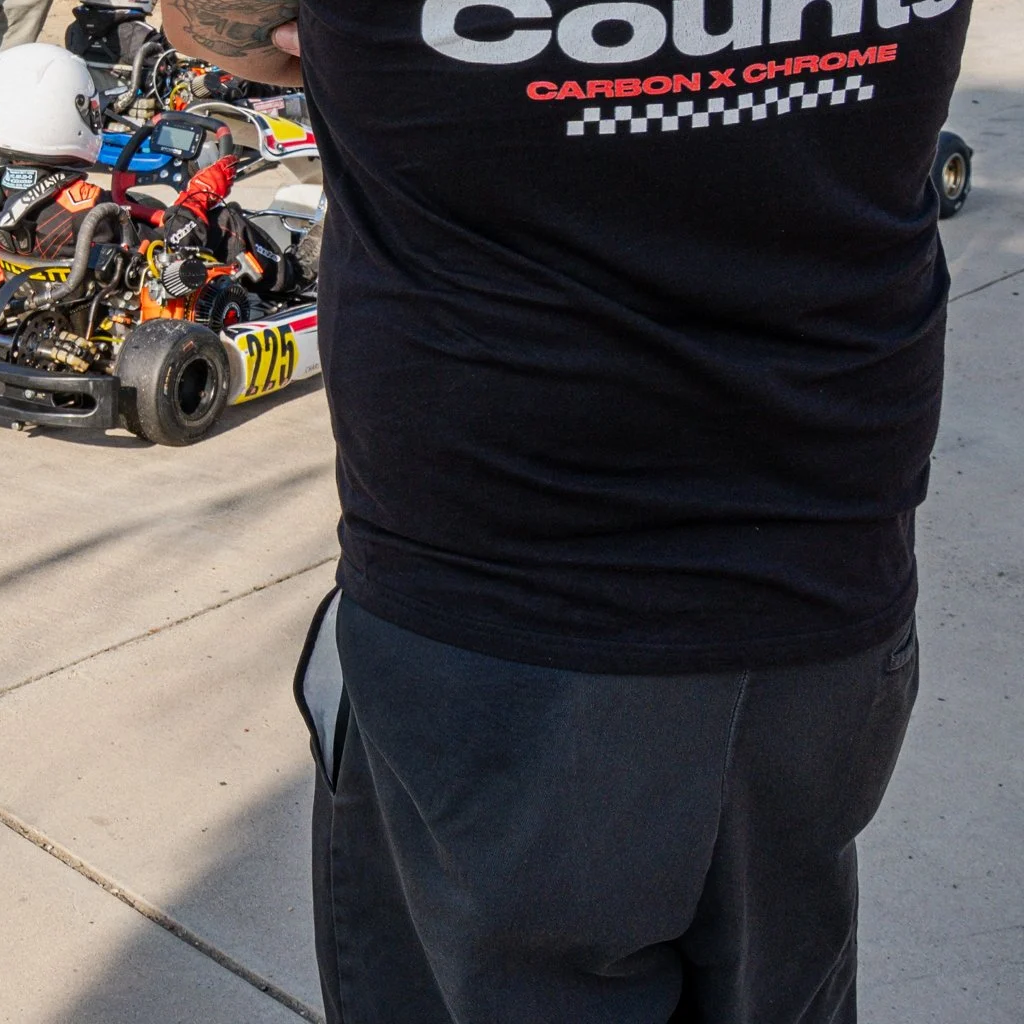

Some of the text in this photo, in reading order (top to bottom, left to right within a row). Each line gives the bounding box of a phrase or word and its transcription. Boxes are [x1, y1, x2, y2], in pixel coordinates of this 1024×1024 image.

[526, 43, 898, 101] CARBON X CHROME
[245, 323, 295, 397] 225
